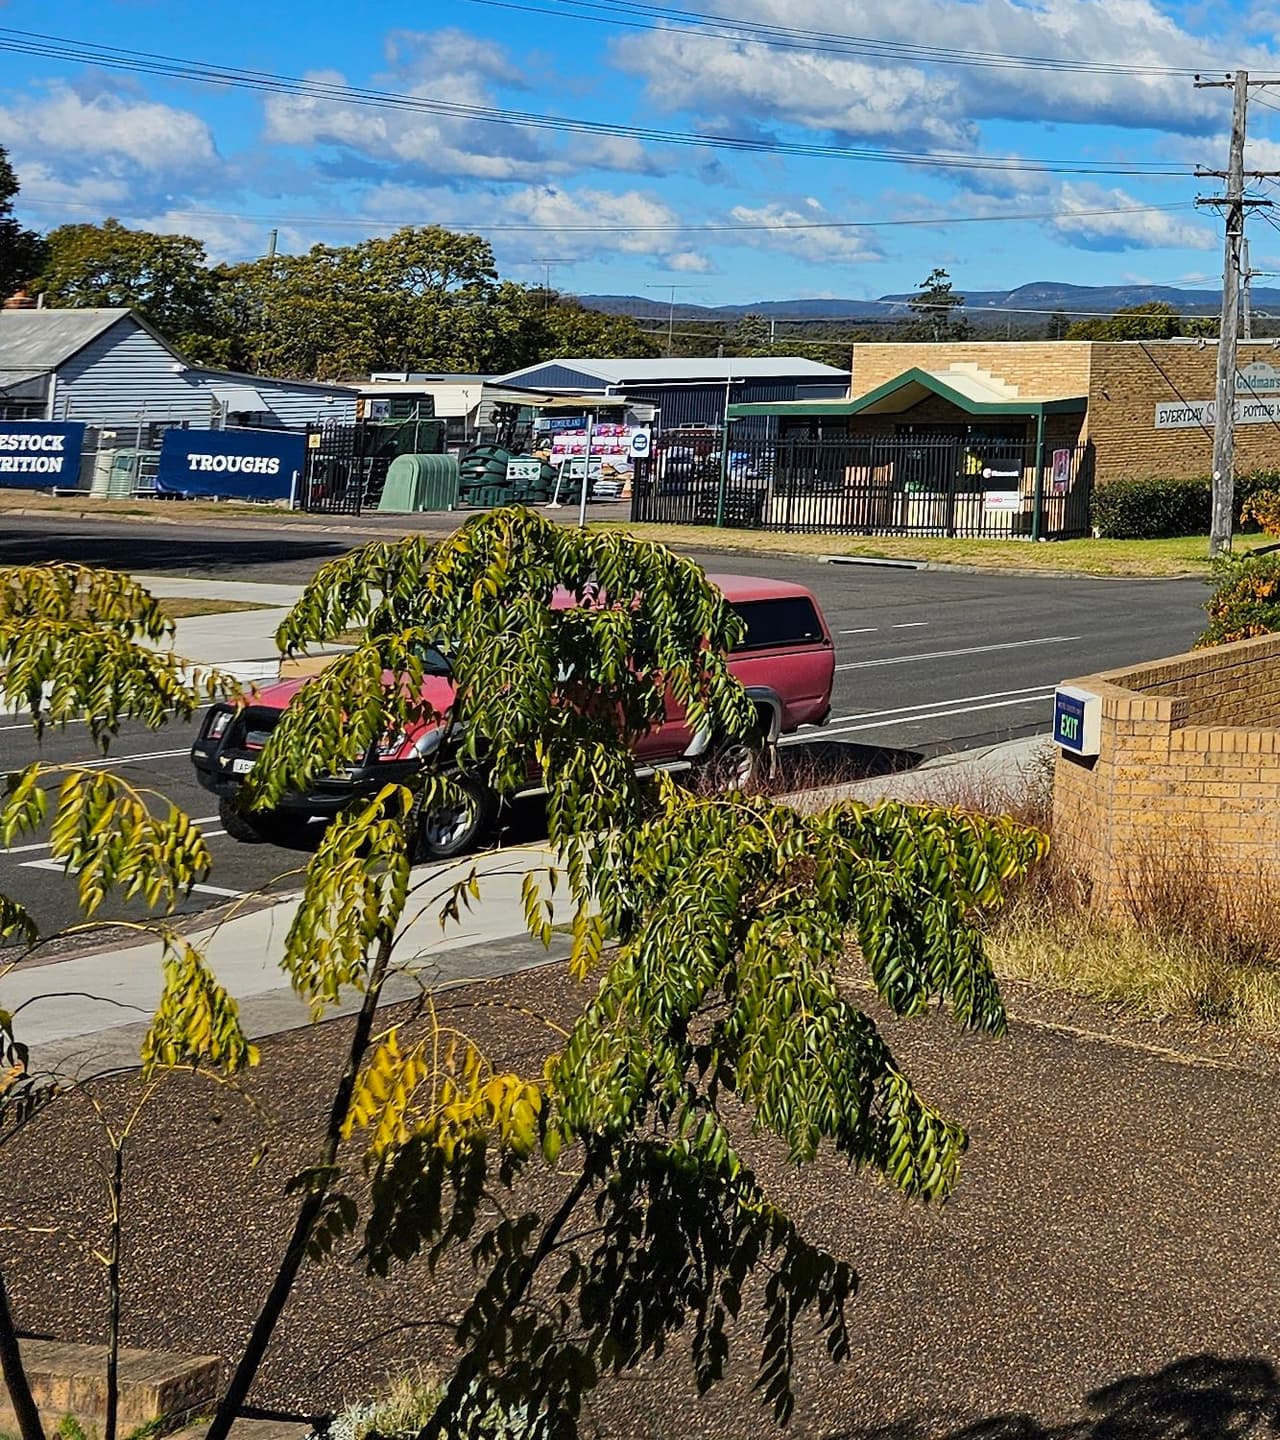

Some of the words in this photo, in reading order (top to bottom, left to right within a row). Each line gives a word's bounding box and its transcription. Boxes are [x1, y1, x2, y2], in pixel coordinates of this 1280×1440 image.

[1235, 375, 1280, 390] Goldman's
[1159, 407, 1204, 424] EVERYDAY
[1243, 404, 1274, 418] POTTING
[187, 454, 281, 475] TROUGHS
[1060, 713, 1079, 741] EXIT
